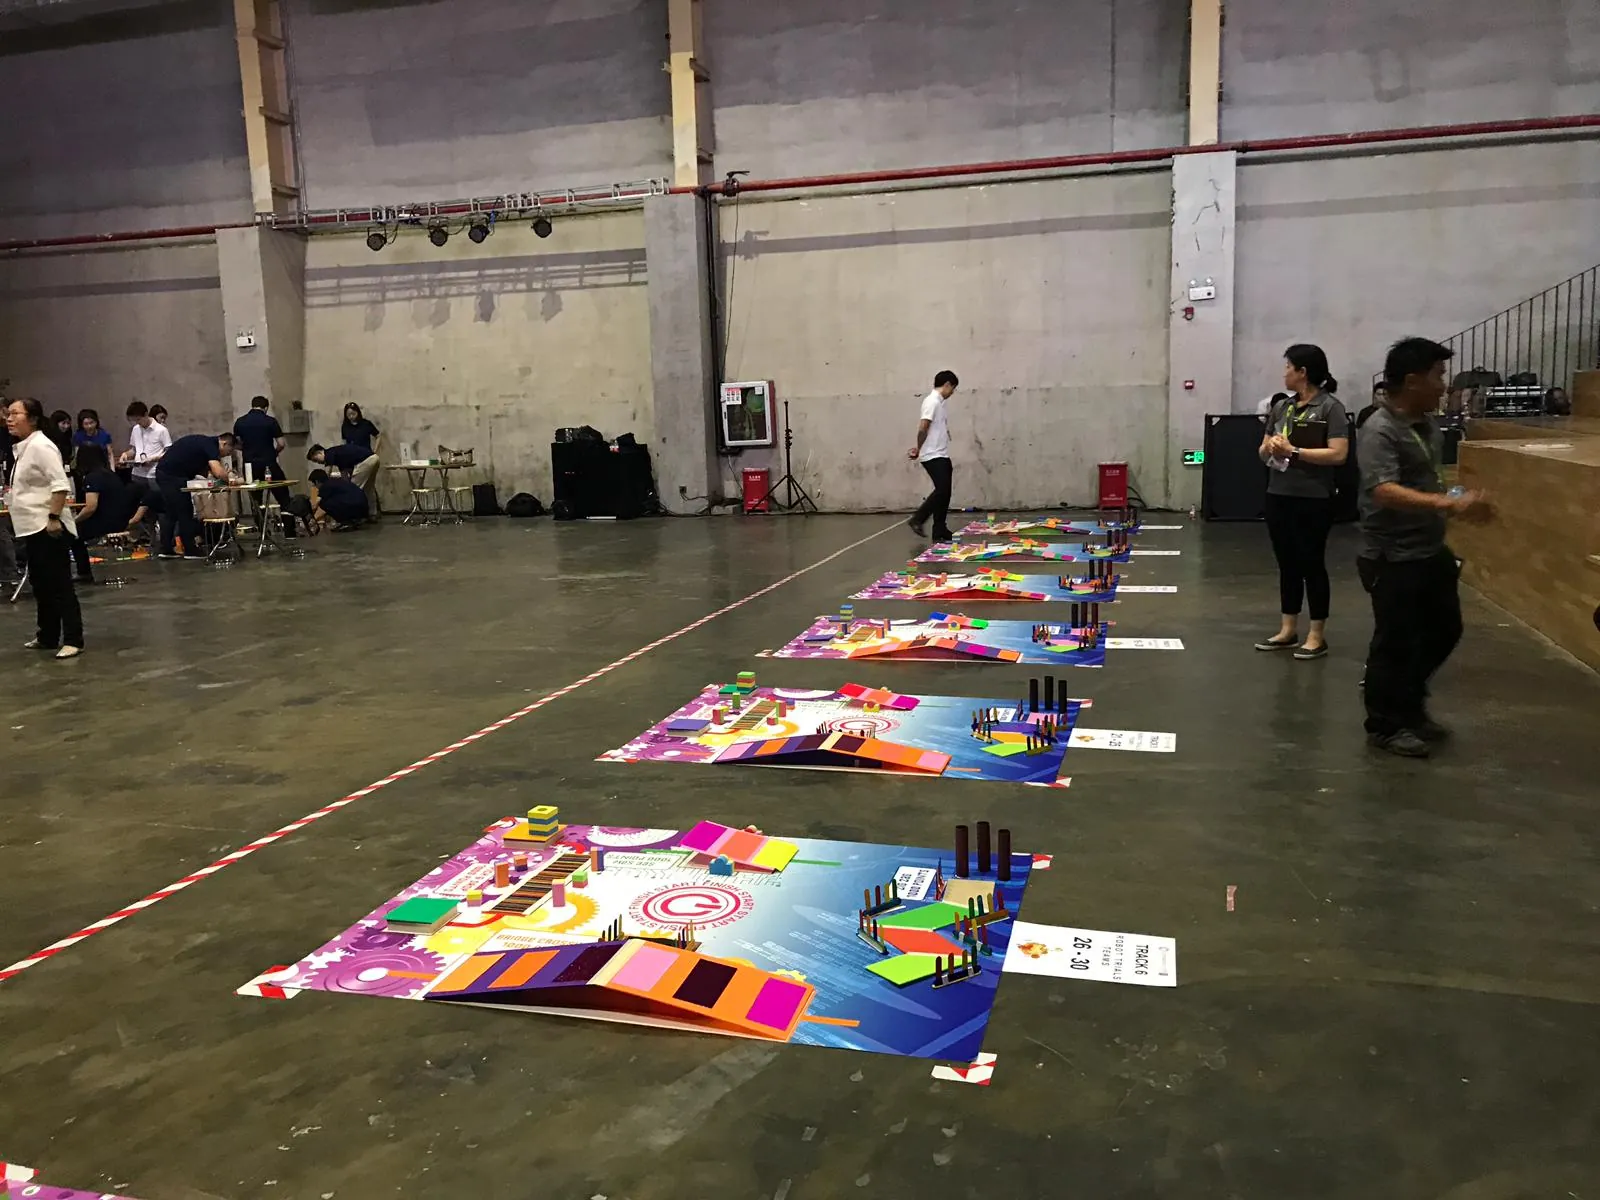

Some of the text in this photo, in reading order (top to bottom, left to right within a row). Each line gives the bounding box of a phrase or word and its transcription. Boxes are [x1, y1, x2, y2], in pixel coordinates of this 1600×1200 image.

[654, 881, 697, 892] START
[702, 879, 743, 893] FINISH
[711, 910, 750, 929] START
[496, 934, 536, 943] BRIDGE
[1073, 936, 1093, 950] 26
[1101, 946, 1112, 967] TEAMS
[1112, 934, 1125, 981] ROBOT TRIALS
[1134, 944, 1149, 977] TRACK 6
[1069, 957, 1091, 971] 30
